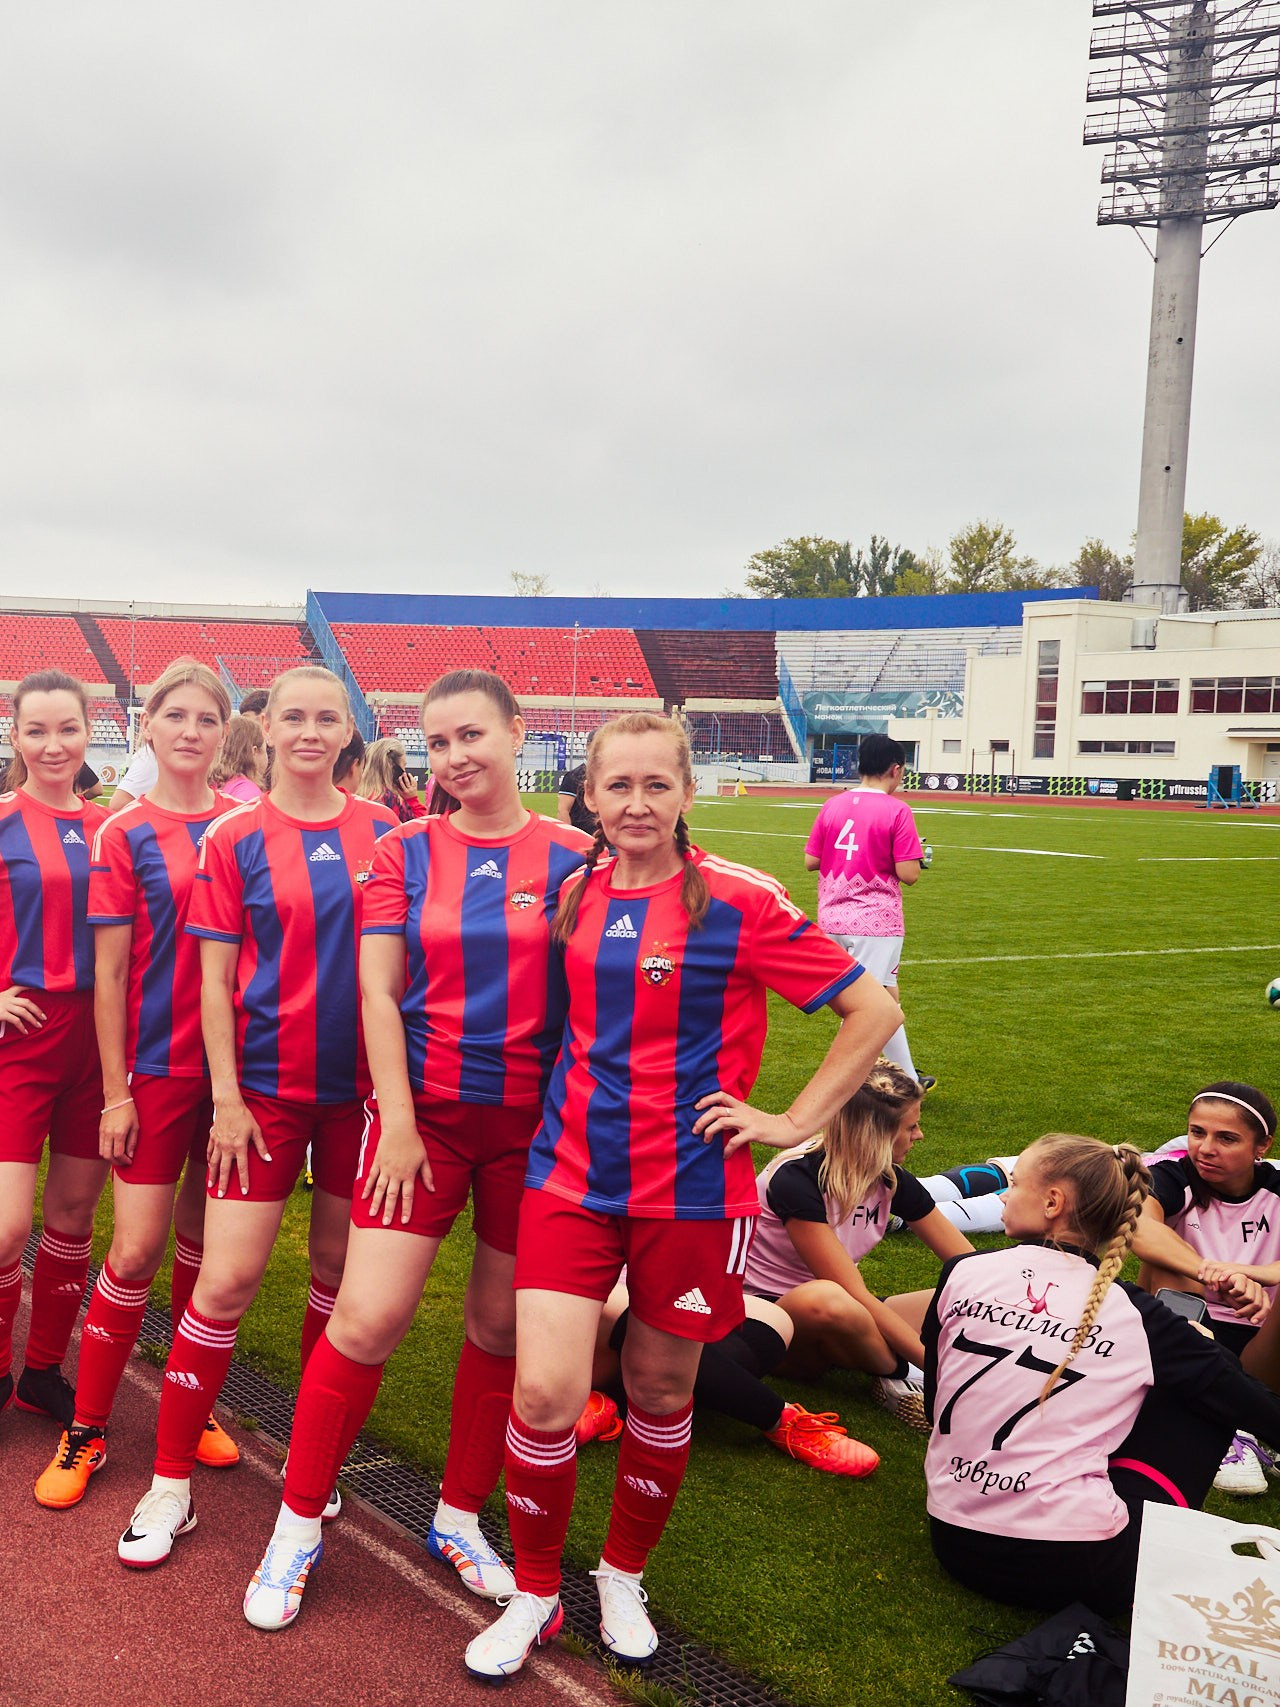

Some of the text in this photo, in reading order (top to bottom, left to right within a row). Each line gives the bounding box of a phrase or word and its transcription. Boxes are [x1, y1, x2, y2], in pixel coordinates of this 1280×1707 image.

[814, 713, 843, 721] манеж
[833, 818, 860, 861] 4
[309, 853, 341, 862] adidas
[470, 868, 503, 879] adidas
[605, 928, 638, 939] adidas
[641, 956, 673, 972] ЦСКА
[673, 1299, 712, 1315] adidas
[165, 1372, 204, 1391] adidas
[938, 1328, 1088, 1451] 77
[624, 1475, 668, 1498] adidas
[1156, 1639, 1269, 1682] ROYAL
[1160, 1662, 1280, 1700] 100% NATURAL ORGAN
